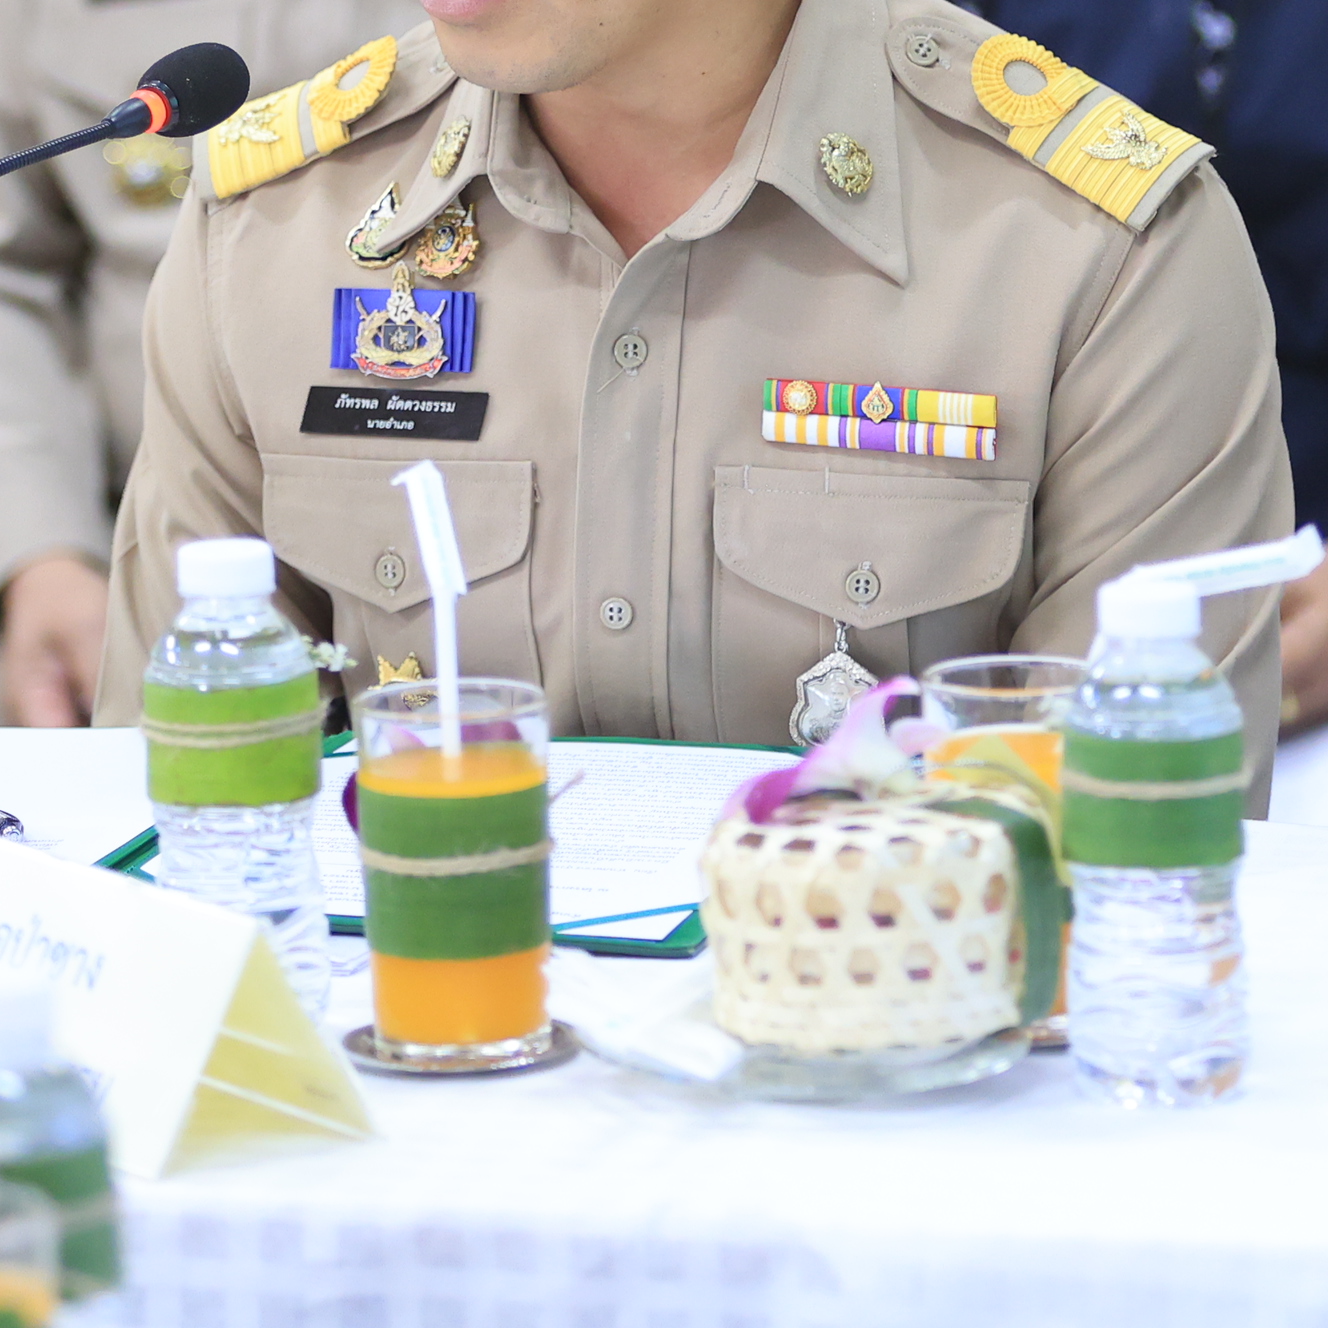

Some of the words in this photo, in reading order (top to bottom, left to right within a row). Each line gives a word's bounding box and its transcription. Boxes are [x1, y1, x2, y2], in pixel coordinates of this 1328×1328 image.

[334, 393, 379, 410] ภัทรพล
[366, 417, 415, 430] นายอำเภอ
